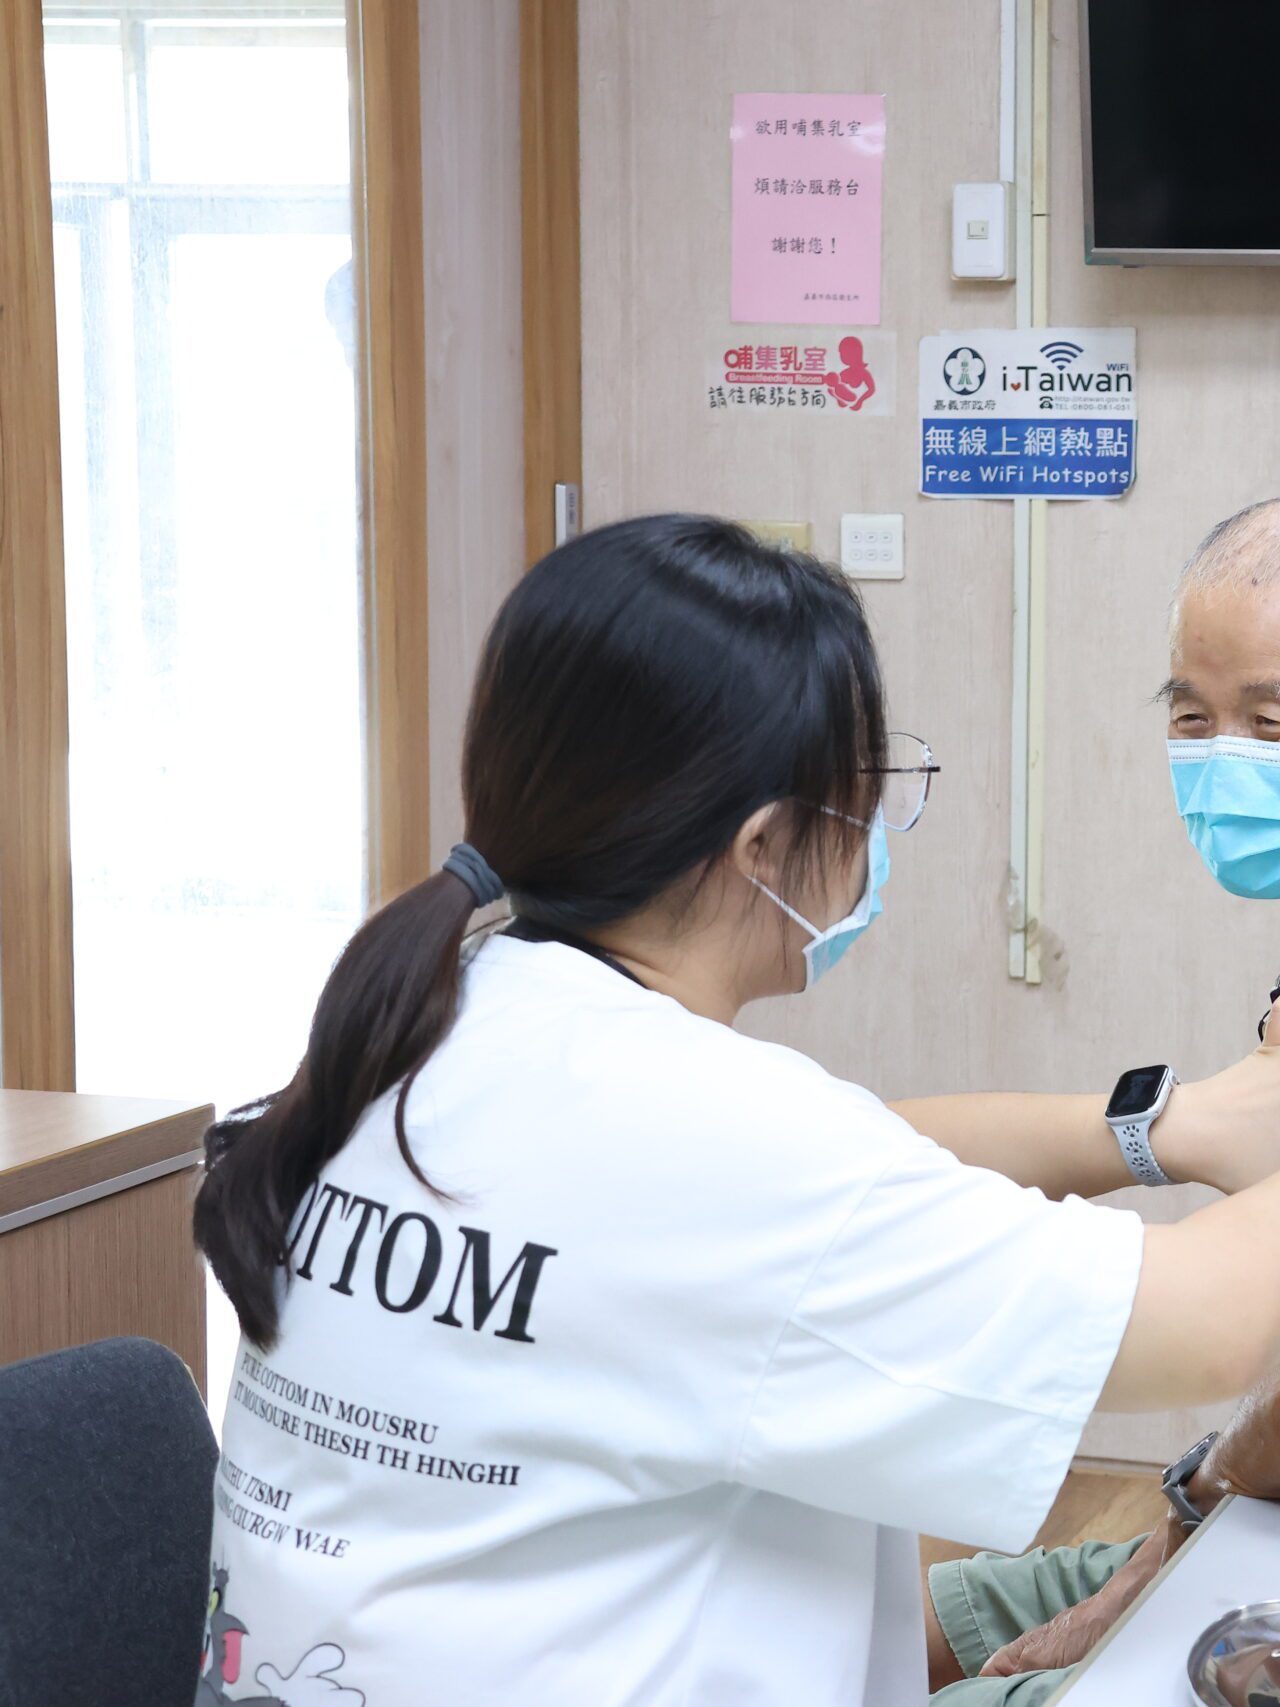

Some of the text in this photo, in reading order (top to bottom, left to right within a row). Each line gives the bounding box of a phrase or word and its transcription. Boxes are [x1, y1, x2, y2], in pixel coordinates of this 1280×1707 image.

[755, 118, 861, 137] 欲用哺集乳室
[754, 177, 859, 196] 煩請洽服務台
[723, 345, 827, 371] 哺集乳室
[1106, 363, 1129, 372] WiFi
[729, 374, 823, 384] Breastfeeding Room
[934, 399, 997, 411] 嘉義市政府
[924, 426, 1129, 458] 無線上網熱點
[925, 465, 1129, 487] Free WiFi Hotspots
[260, 1366, 309, 1408] COTTOM
[311, 1390, 334, 1416] IN
[335, 1400, 439, 1444] MOUSRU
[304, 1420, 371, 1460] THESH
[376, 1443, 411, 1470] TH
[416, 1453, 521, 1486] HINGHI
[295, 1527, 351, 1558] WAE
